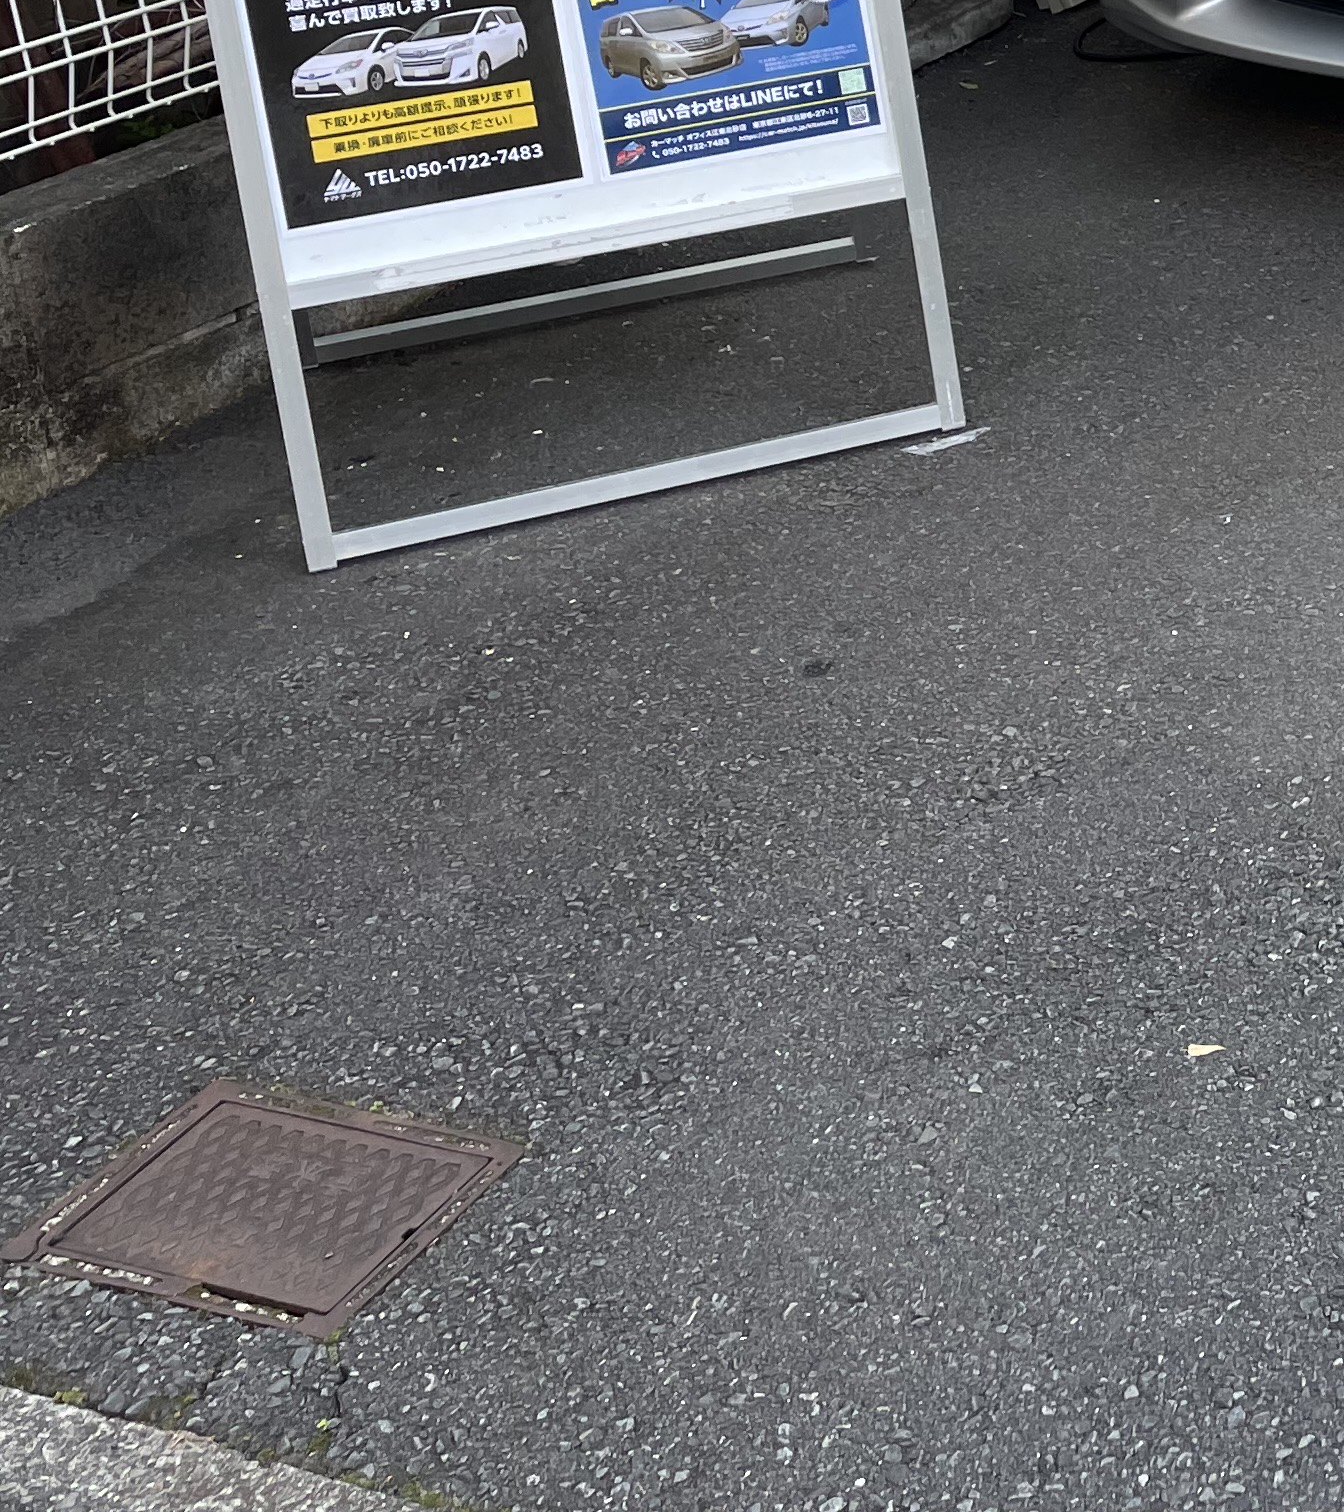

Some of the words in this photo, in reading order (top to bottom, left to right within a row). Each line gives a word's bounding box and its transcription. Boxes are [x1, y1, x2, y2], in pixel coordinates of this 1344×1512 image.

[623, 78, 825, 130] お問い合わせはLINEにて!
[363, 143, 545, 188] TEL:050-1722-7483
